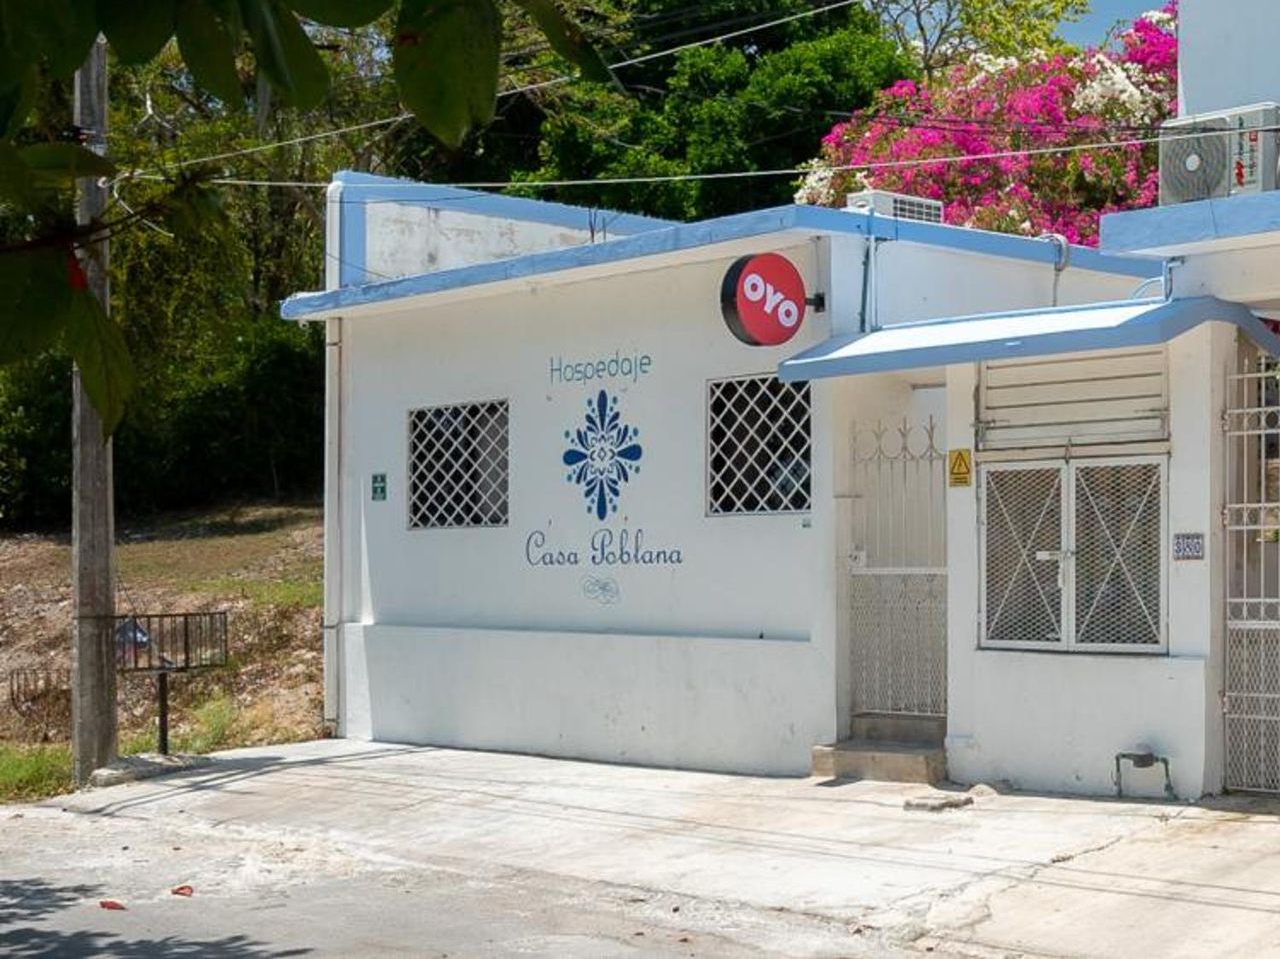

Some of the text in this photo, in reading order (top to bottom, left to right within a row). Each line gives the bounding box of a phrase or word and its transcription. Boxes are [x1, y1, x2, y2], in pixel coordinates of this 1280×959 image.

[743, 273, 798, 327] OYO
[550, 352, 652, 384] Hospedaje
[525, 528, 683, 566] Casa Poblana
